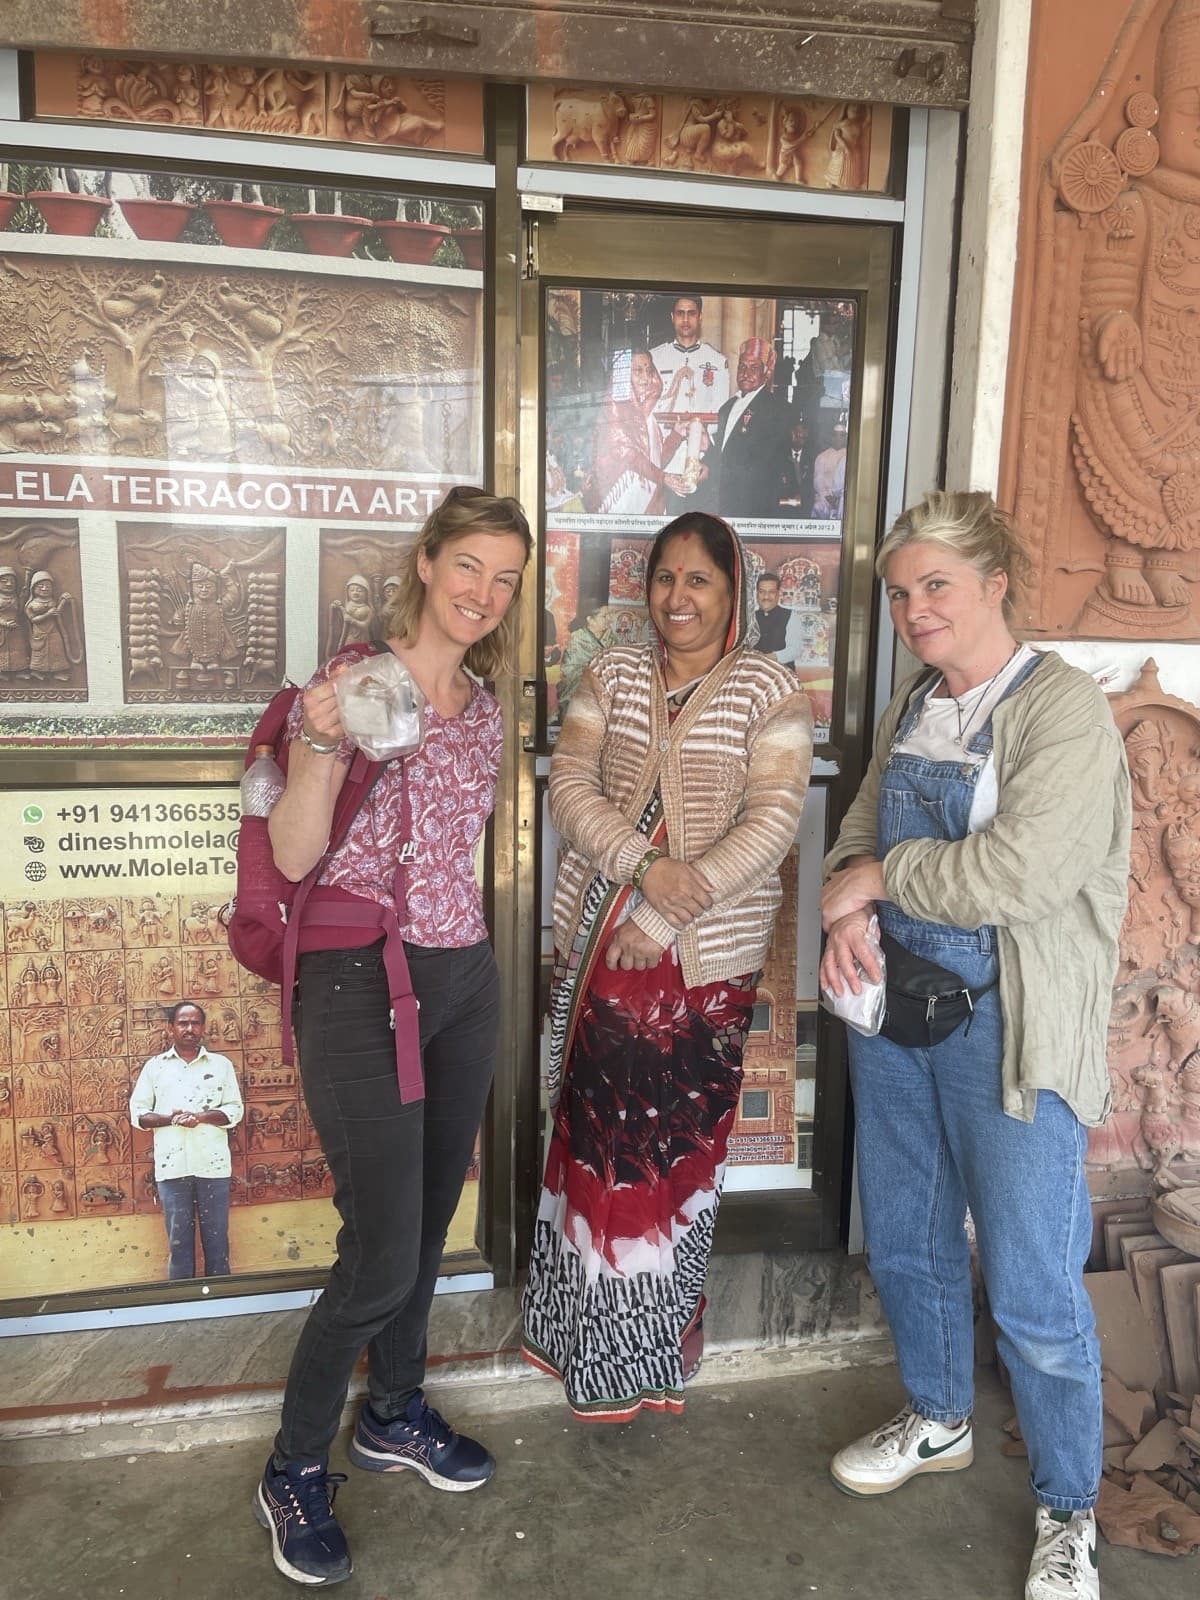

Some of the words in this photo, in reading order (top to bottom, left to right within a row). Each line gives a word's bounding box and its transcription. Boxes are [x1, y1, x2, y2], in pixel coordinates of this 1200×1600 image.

[0, 470, 94, 503] ELA
[103, 474, 360, 514] TERRACOTTA
[368, 487, 441, 516] ART
[57, 804, 99, 823] +91
[110, 803, 240, 823] 941366535
[59, 856, 236, 878] www.MolelaTe
